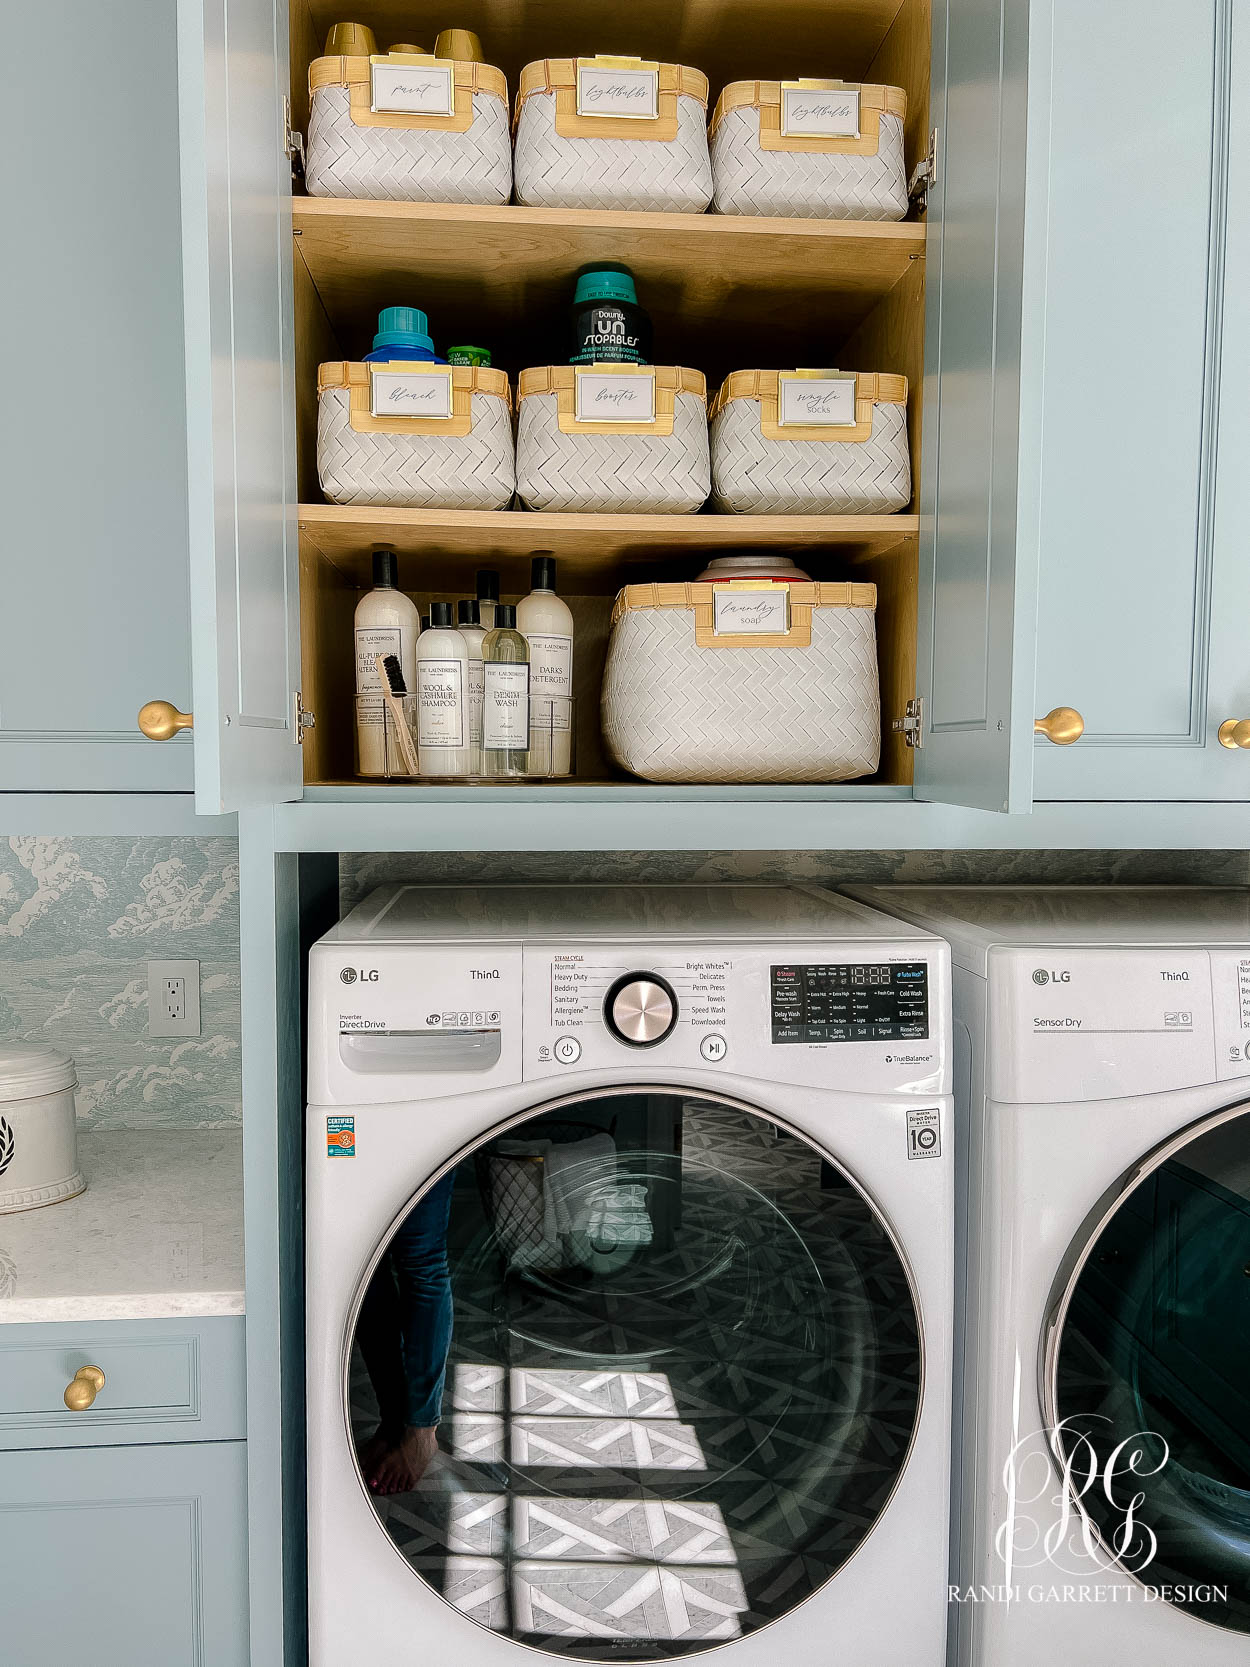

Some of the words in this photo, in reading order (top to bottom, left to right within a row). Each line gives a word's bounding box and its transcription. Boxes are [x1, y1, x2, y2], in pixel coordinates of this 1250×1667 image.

[598, 310, 624, 321] Downy
[584, 334, 637, 347] STOPABLES
[807, 405, 831, 414] socks
[740, 617, 762, 625] soap
[540, 666, 563, 675] DARKS
[422, 684, 445, 692] WOOL
[420, 691, 457, 699] CASHMERE
[495, 699, 518, 707] WASH
[554, 963, 576, 971] Normal
[686, 962, 704, 971] Bright
[359, 969, 380, 982] LG
[470, 969, 501, 980] ThinQ
[554, 973, 573, 982] Heavy
[573, 973, 588, 982] Duty
[1052, 971, 1071, 983] LG
[1160, 971, 1189, 981] ThinQ
[554, 984, 578, 994] Bedding
[554, 995, 578, 1004] Sanitary
[691, 1006, 709, 1014] Speed
[788, 1010, 801, 1018] Wash
[554, 1019, 566, 1027] Tub
[567, 1019, 584, 1027] Clean
[691, 1018, 726, 1026] Downloaded
[911, 1128, 937, 1150] 10
